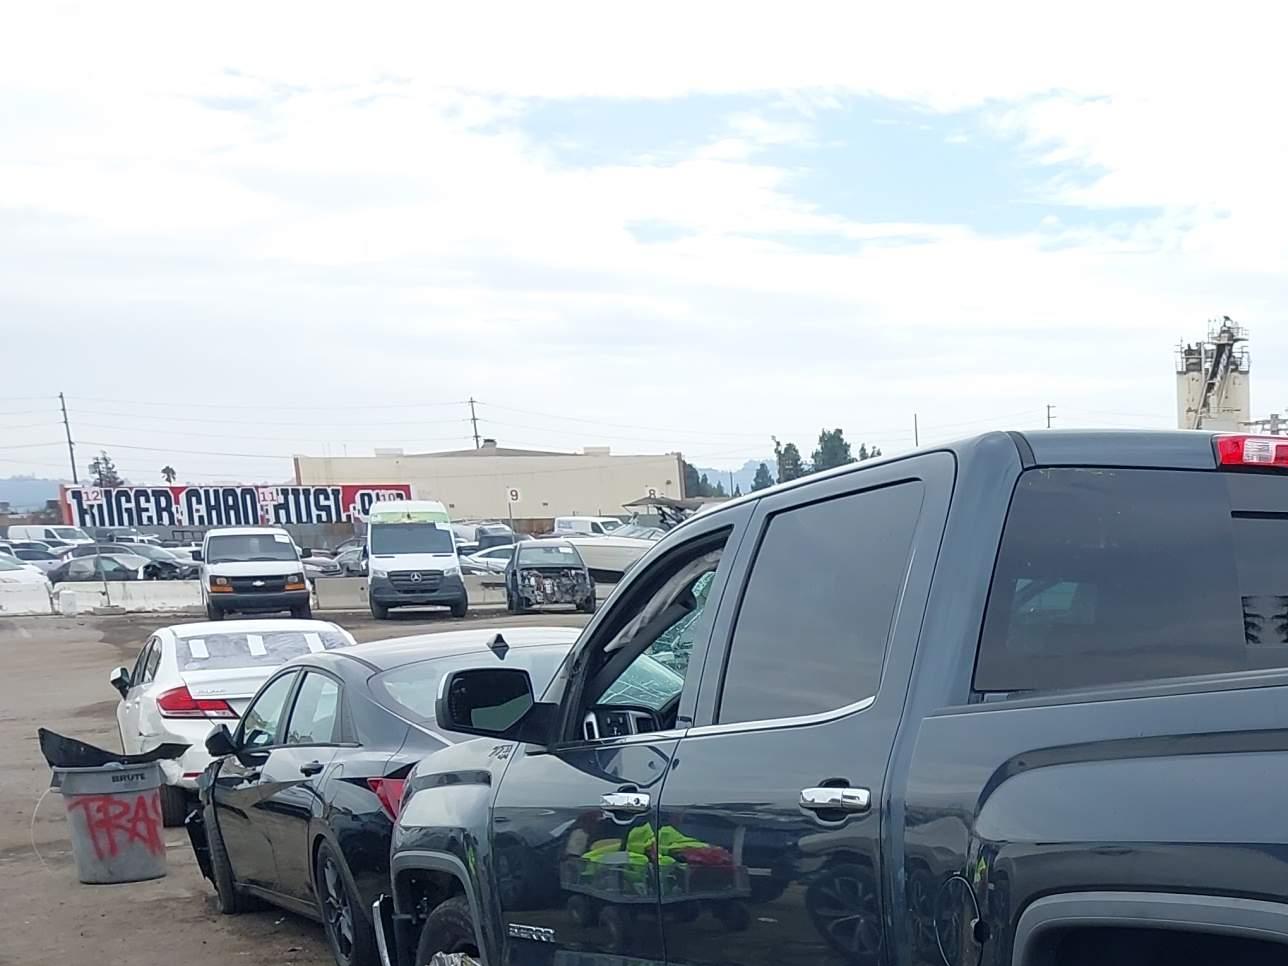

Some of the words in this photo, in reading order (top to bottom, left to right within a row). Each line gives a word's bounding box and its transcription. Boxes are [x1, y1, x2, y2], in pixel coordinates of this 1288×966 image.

[83, 489, 102, 502] 12
[261, 491, 277, 502] 11
[510, 489, 519, 501] 9
[111, 772, 147, 783] BRUTE
